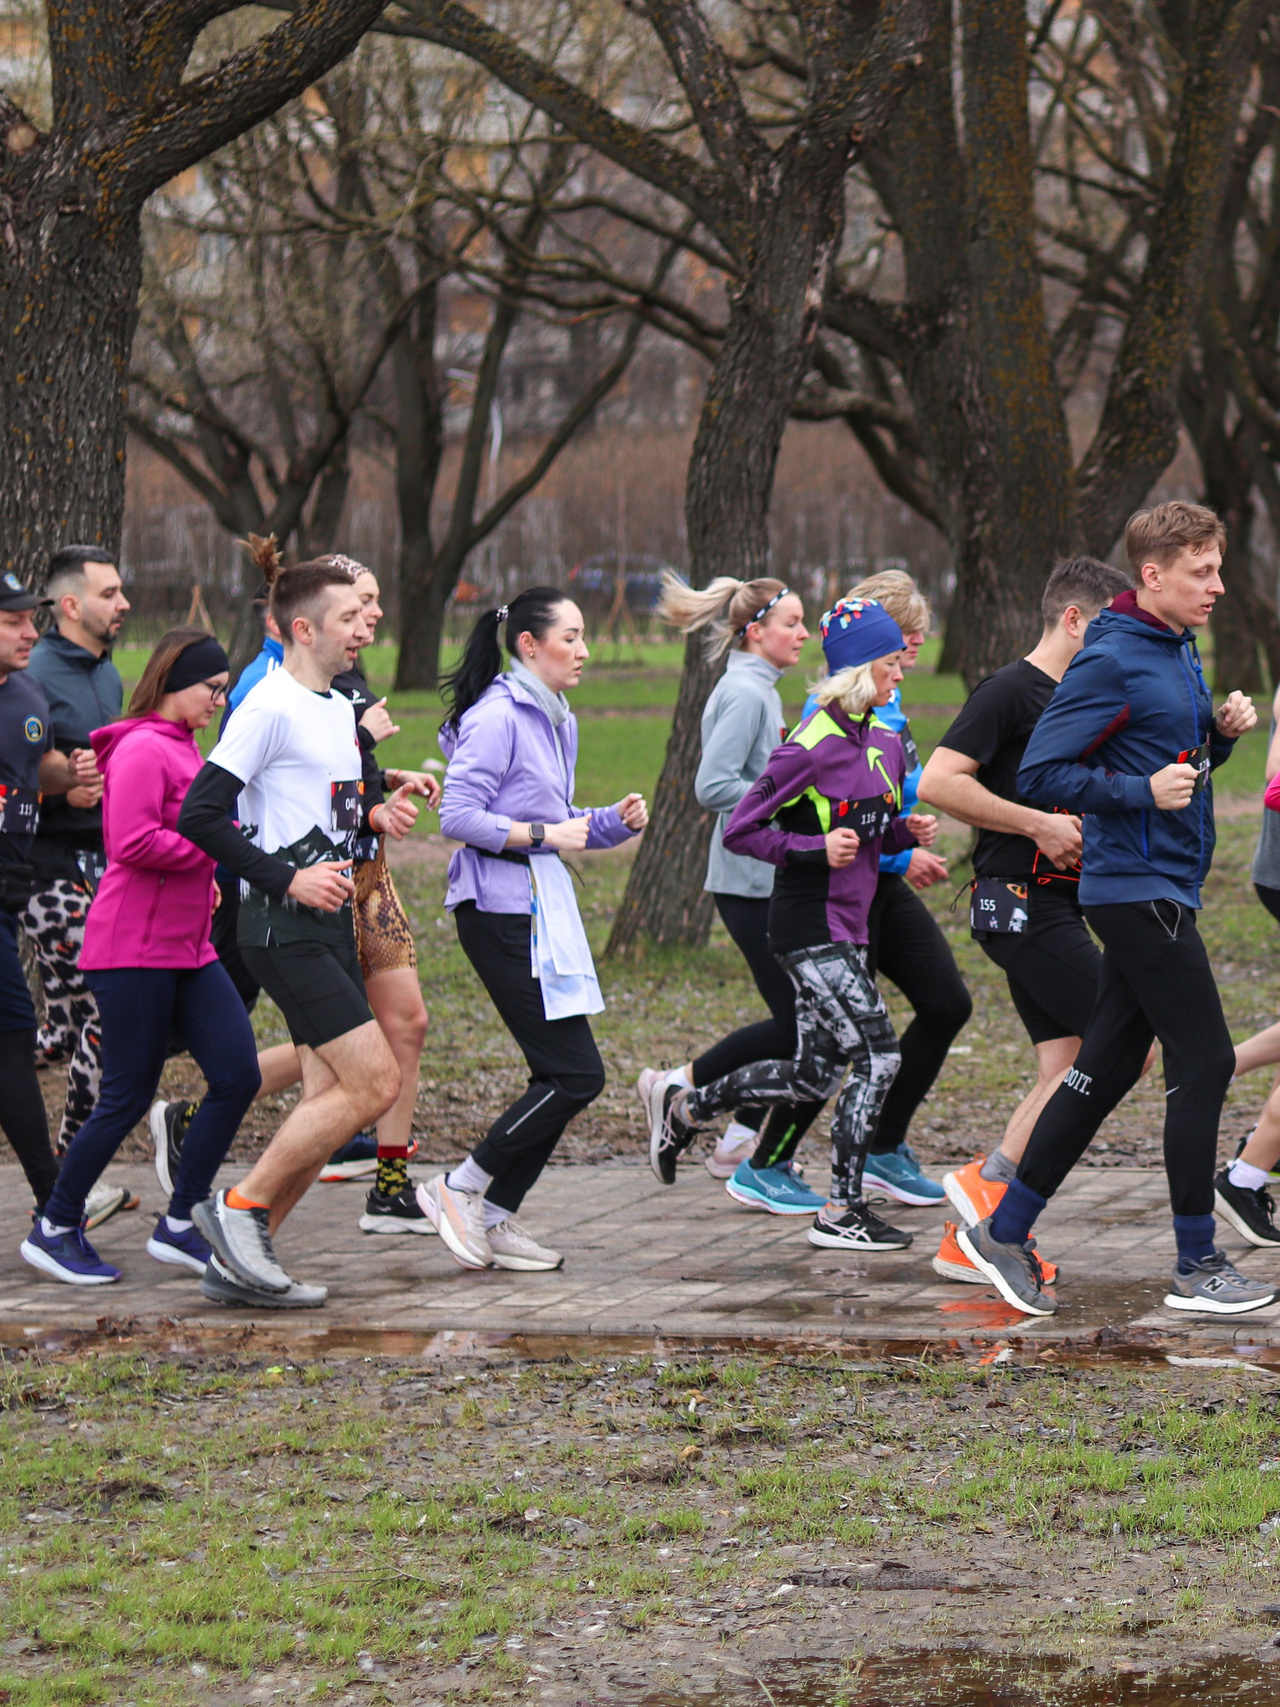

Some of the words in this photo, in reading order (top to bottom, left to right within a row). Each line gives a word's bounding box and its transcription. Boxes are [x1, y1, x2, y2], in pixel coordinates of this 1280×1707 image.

[861, 812, 876, 825] 116
[980, 898, 996, 912] 155
[1202, 1275, 1227, 1294] N
